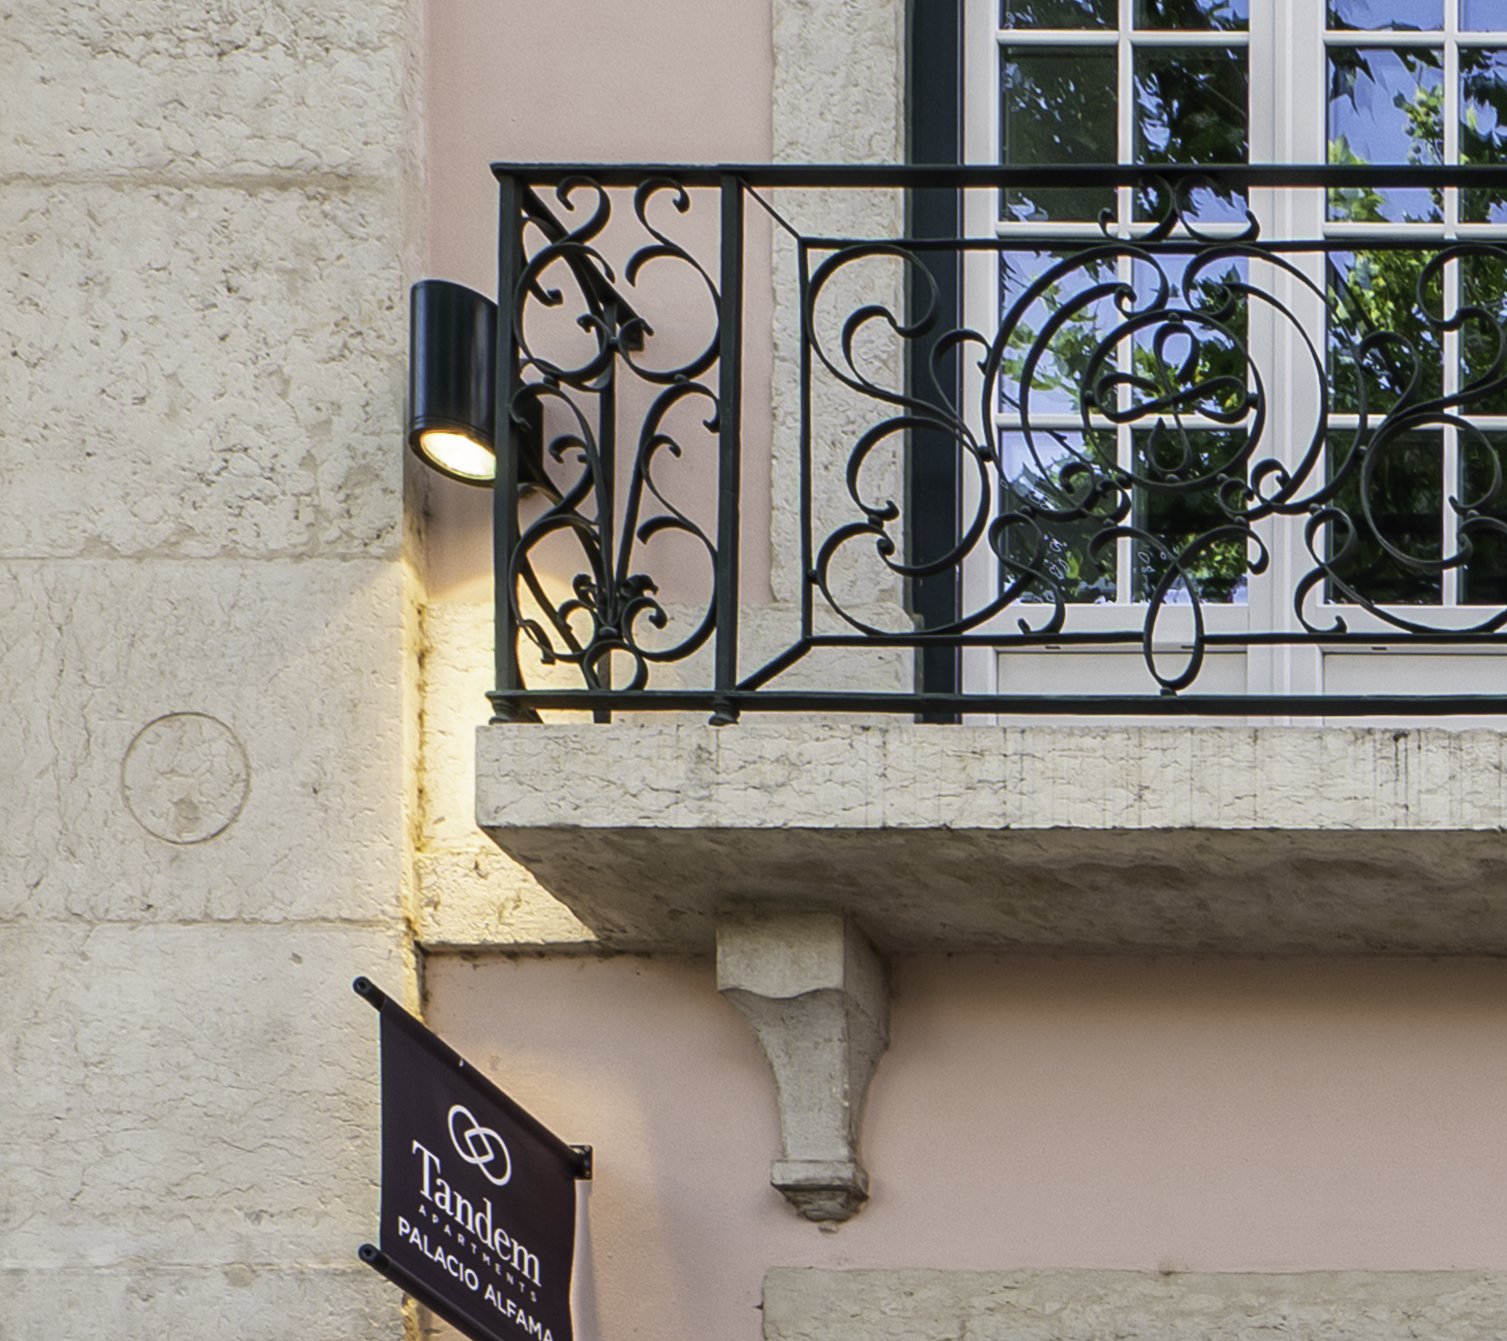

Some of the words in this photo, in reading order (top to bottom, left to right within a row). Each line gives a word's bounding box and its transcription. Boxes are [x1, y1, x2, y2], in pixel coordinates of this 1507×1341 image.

[398, 1215, 479, 1291] PALACIO
[412, 1139, 542, 1288] Tandem
[418, 1204, 538, 1303] APARTMENTS
